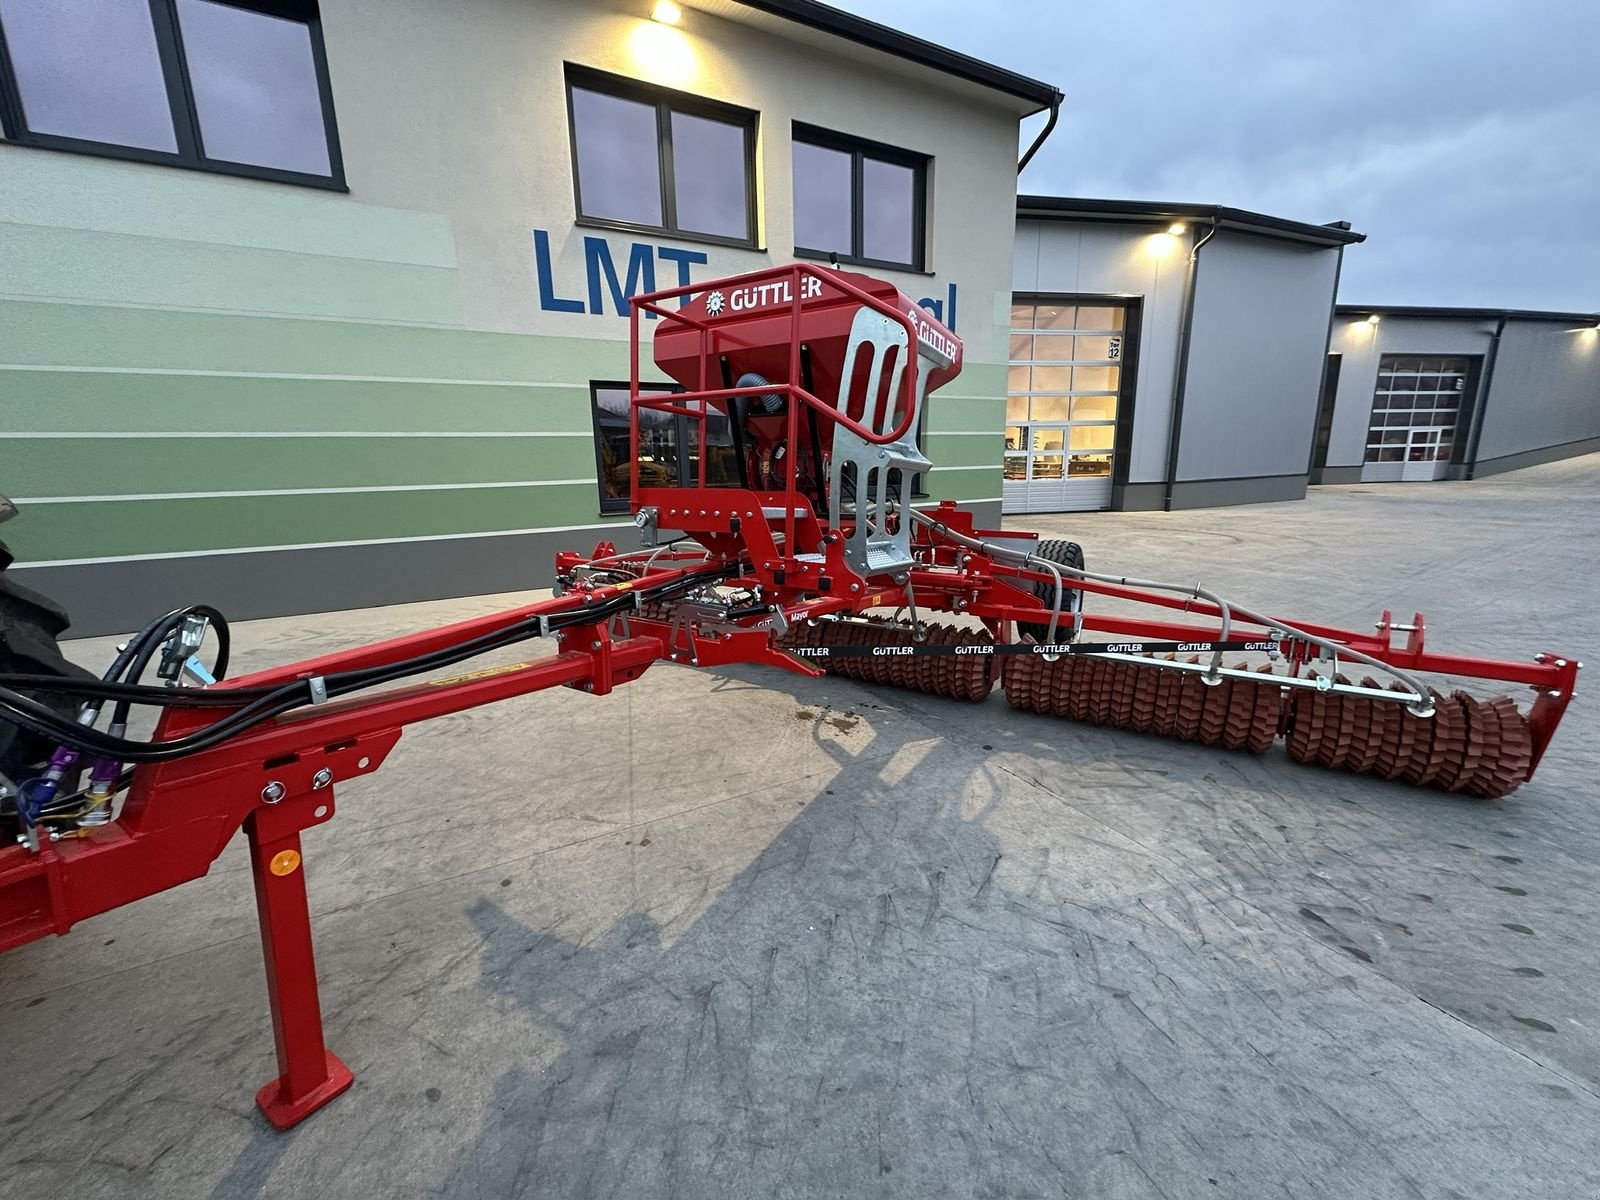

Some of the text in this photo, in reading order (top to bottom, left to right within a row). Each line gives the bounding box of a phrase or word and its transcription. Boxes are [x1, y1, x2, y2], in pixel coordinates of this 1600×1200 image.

[534, 229, 707, 320] LMT
[730, 276, 823, 311] GÜTTLER
[1110, 348, 1119, 357] 12
[791, 610, 809, 622] Mayor
[872, 646, 914, 656] GÜTTLER
[955, 645, 994, 654] GÜTTLER
[1033, 644, 1070, 653] GÜTTLER
[1107, 643, 1143, 652] GÜTTLER
[1177, 642, 1211, 651] GÜTTLER
